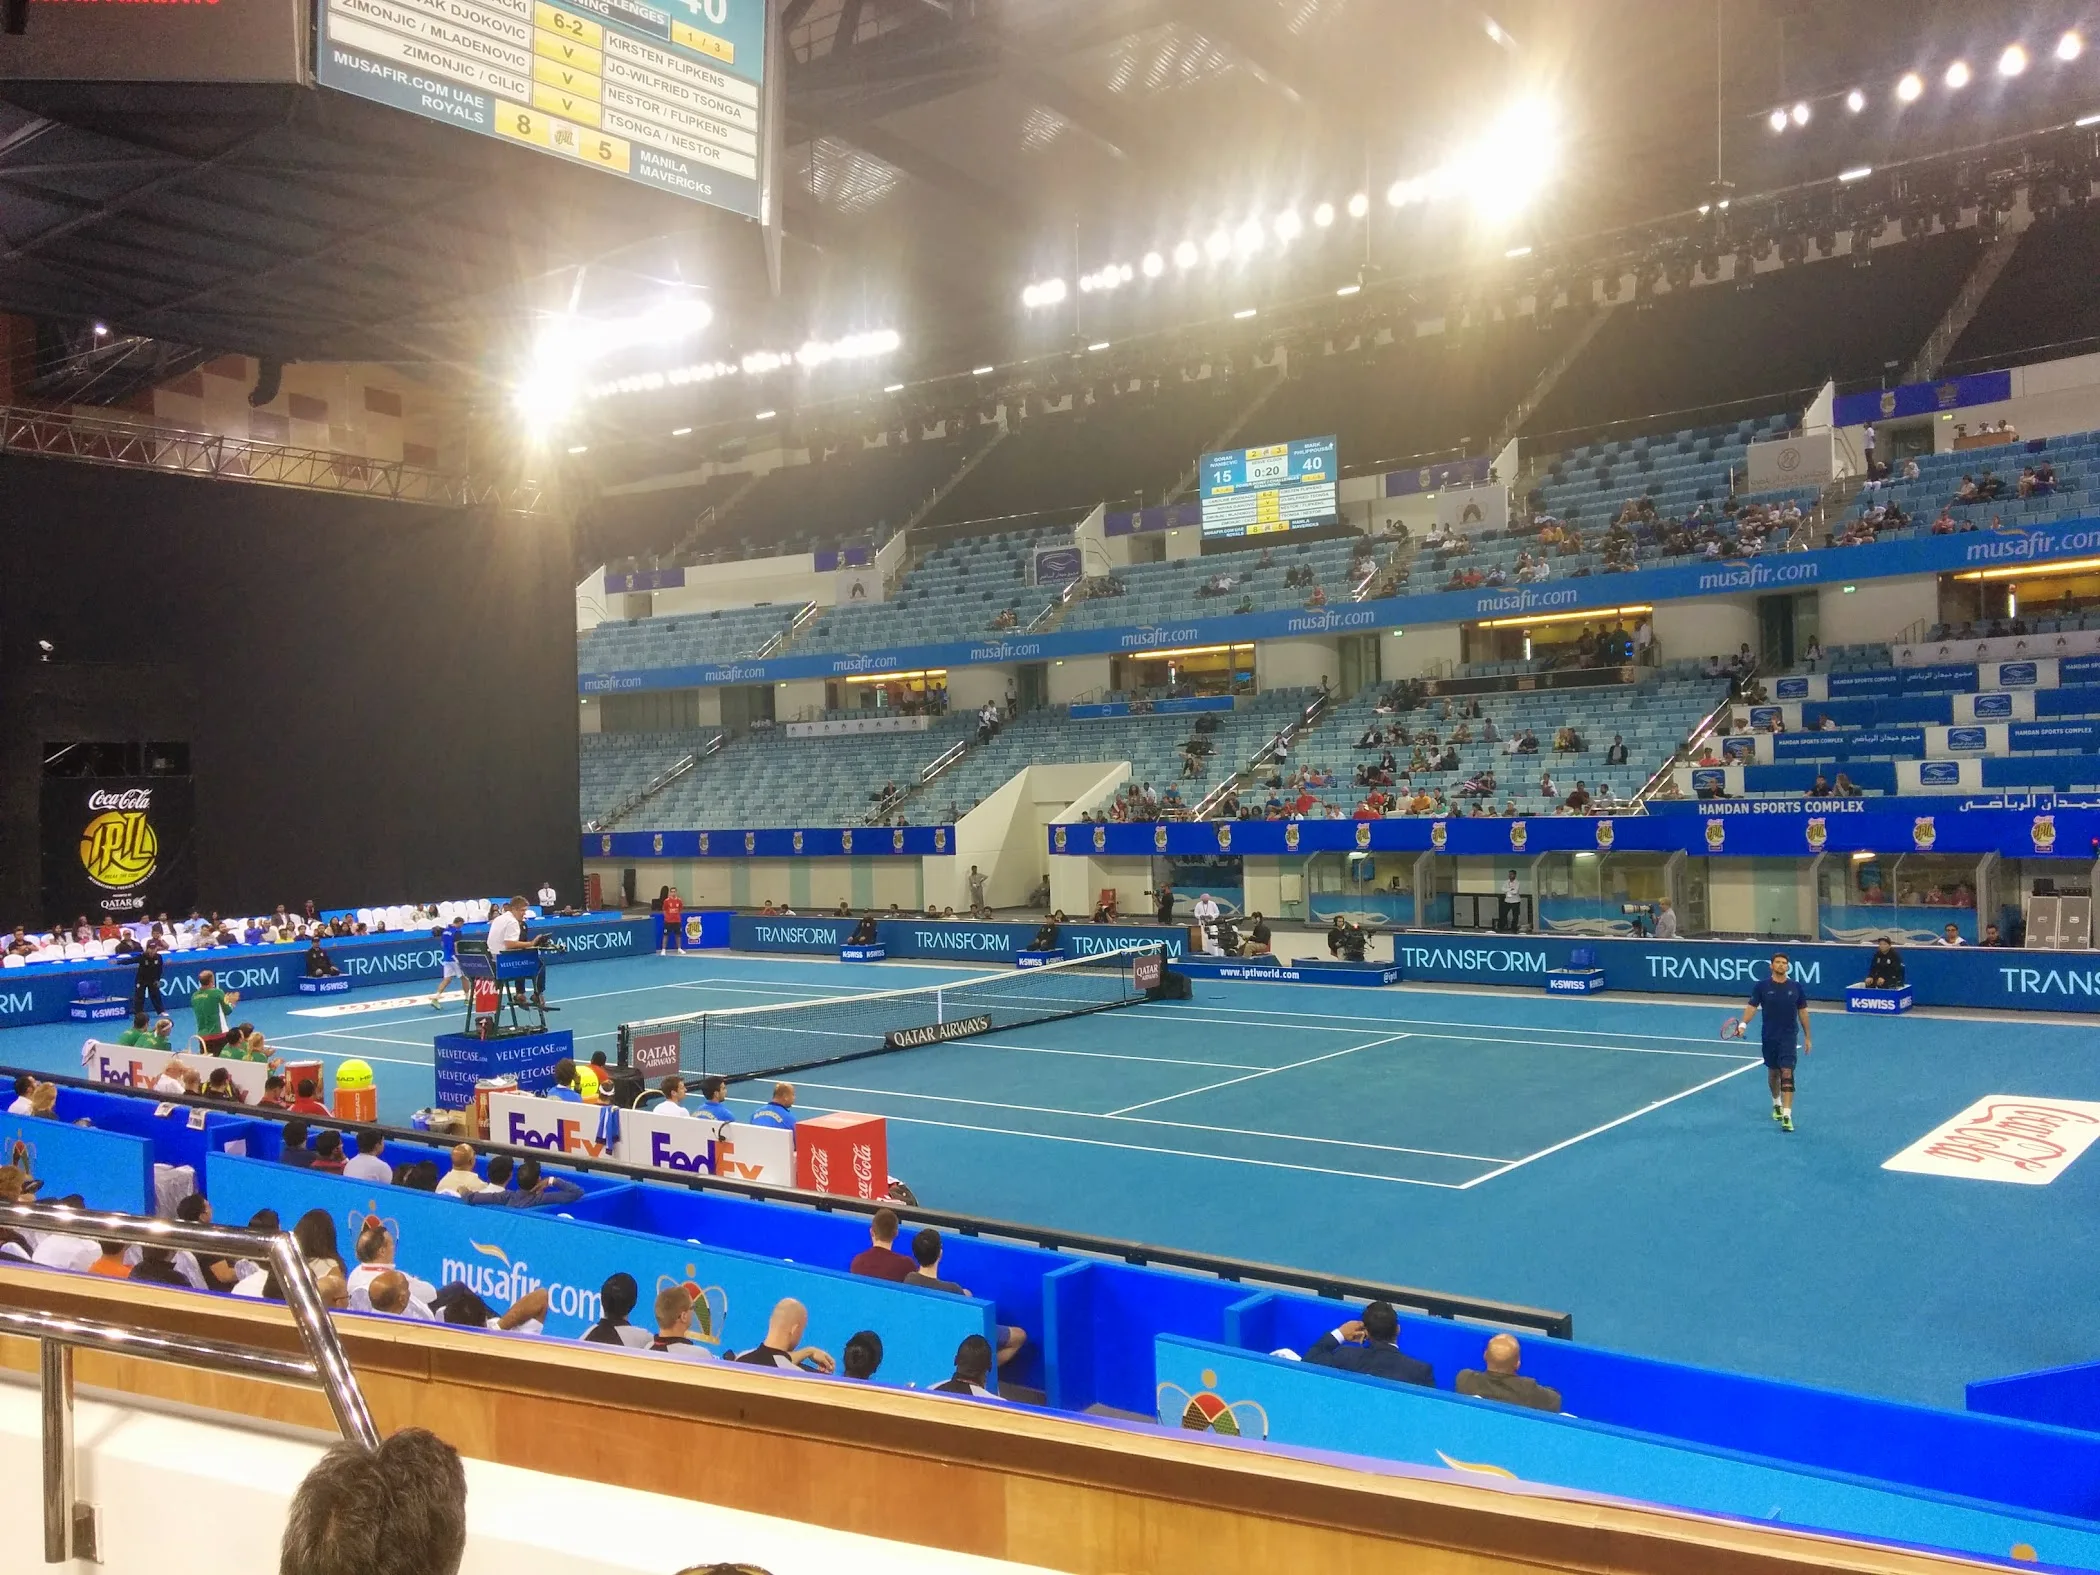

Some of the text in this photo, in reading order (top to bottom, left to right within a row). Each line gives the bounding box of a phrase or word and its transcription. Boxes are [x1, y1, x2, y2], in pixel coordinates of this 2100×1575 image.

[451, 4, 525, 39] DJOKOVIC
[553, 13, 583, 37] 6-2
[430, 25, 526, 67] MLADENOVIC
[403, 44, 475, 77] ZIMONJIC
[488, 73, 525, 94] CILIC
[609, 35, 725, 88] KIRSTEN FLIPKENS
[333, 51, 484, 109] MUSAFIR.COM UAE
[608, 63, 742, 119] JO-WILFRIED TSONGA
[421, 95, 484, 124] ROYALS
[608, 87, 660, 115] NESTOR
[670, 110, 728, 138] FLIPKENS
[516, 114, 531, 136] 8
[608, 113, 661, 140] TSONGA
[672, 135, 720, 160] NESTOR
[598, 140, 612, 161] 5
[640, 151, 689, 174] MANILA
[640, 164, 712, 195] MAVERICKS
[1254, 466, 1279, 478] 0:20
[1303, 457, 1322, 470] 40
[1213, 470, 1232, 483] 15
[1700, 561, 1818, 589] musafir.com
[1477, 588, 1577, 613] musafir.com
[1288, 609, 1374, 631] musafir.com
[1121, 629, 1198, 647] musafir.com
[833, 654, 897, 671] musafir.com
[970, 642, 1041, 660] musafir.com
[585, 675, 641, 691] musafir.com
[705, 666, 765, 682] musafir.com
[89, 789, 153, 811] Coca-Cola
[1699, 801, 1864, 815] HAMDAN SPORTS COMPLEX
[101, 898, 132, 910] QATAR
[755, 926, 837, 945] TRANSFORM
[915, 931, 1010, 952] TRANSFORM
[344, 950, 445, 976] TRANSFOR
[1136, 963, 1159, 977] QATAR
[1402, 947, 1547, 973] TRANSFORM
[1220, 967, 1300, 980] www.iptlworld.com
[894, 1016, 989, 1047] QATAR AIRWAYS
[637, 1044, 677, 1063] QATAR
[646, 1055, 677, 1068] AIRWAYS
[508, 1112, 605, 1157] FedEx
[652, 1131, 764, 1180] FedEx
[852, 1142, 871, 1199] ca-Cola
[441, 1258, 605, 1322] musafircom
